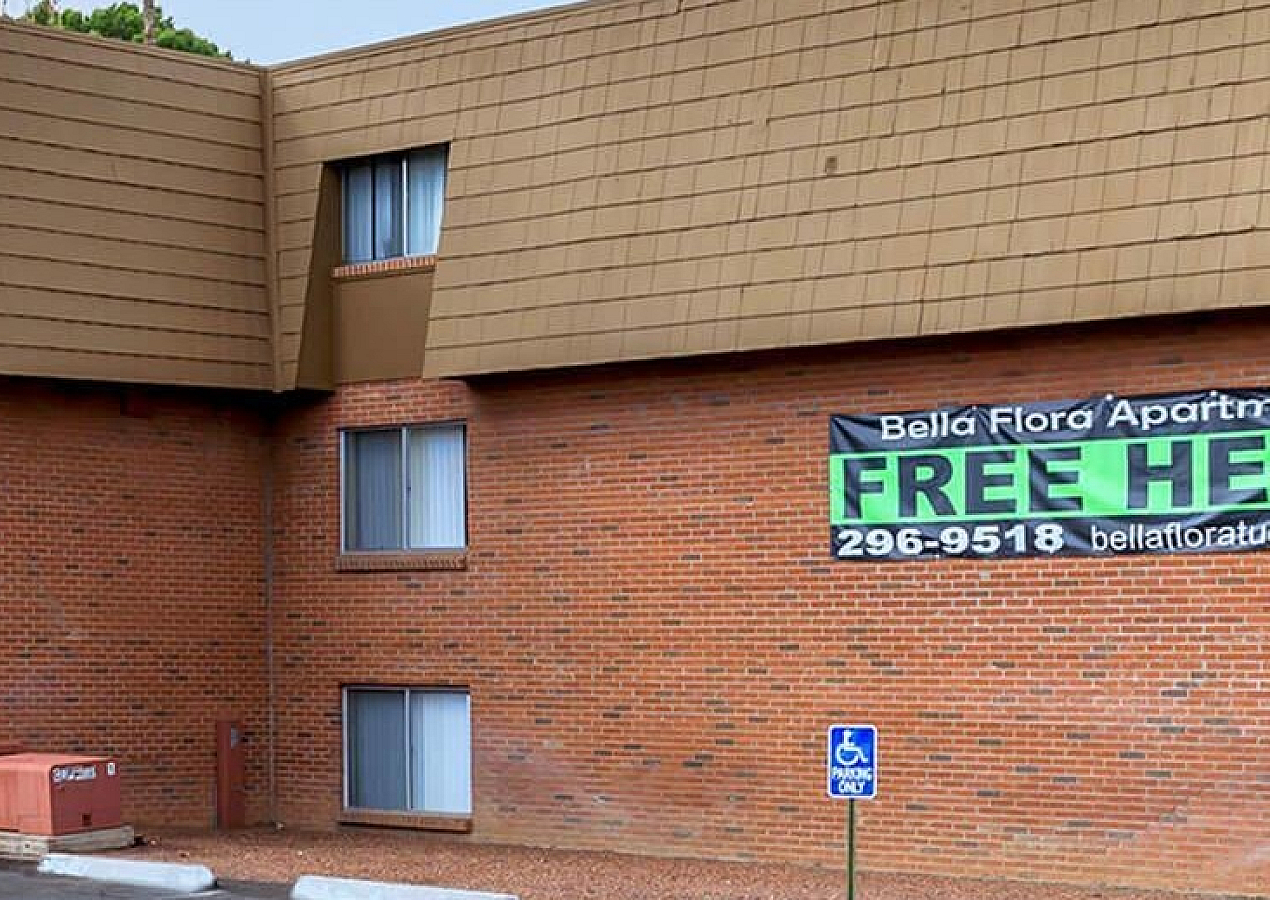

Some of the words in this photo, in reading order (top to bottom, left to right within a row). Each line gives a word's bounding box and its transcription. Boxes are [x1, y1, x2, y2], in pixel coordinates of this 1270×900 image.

[881, 412, 976, 440] Bella
[990, 405, 1093, 434] Flora
[844, 446, 1083, 519] FREE
[1127, 435, 1268, 510] HE
[837, 523, 1064, 556] 296-9518
[1091, 519, 1270, 551] bellafloratu
